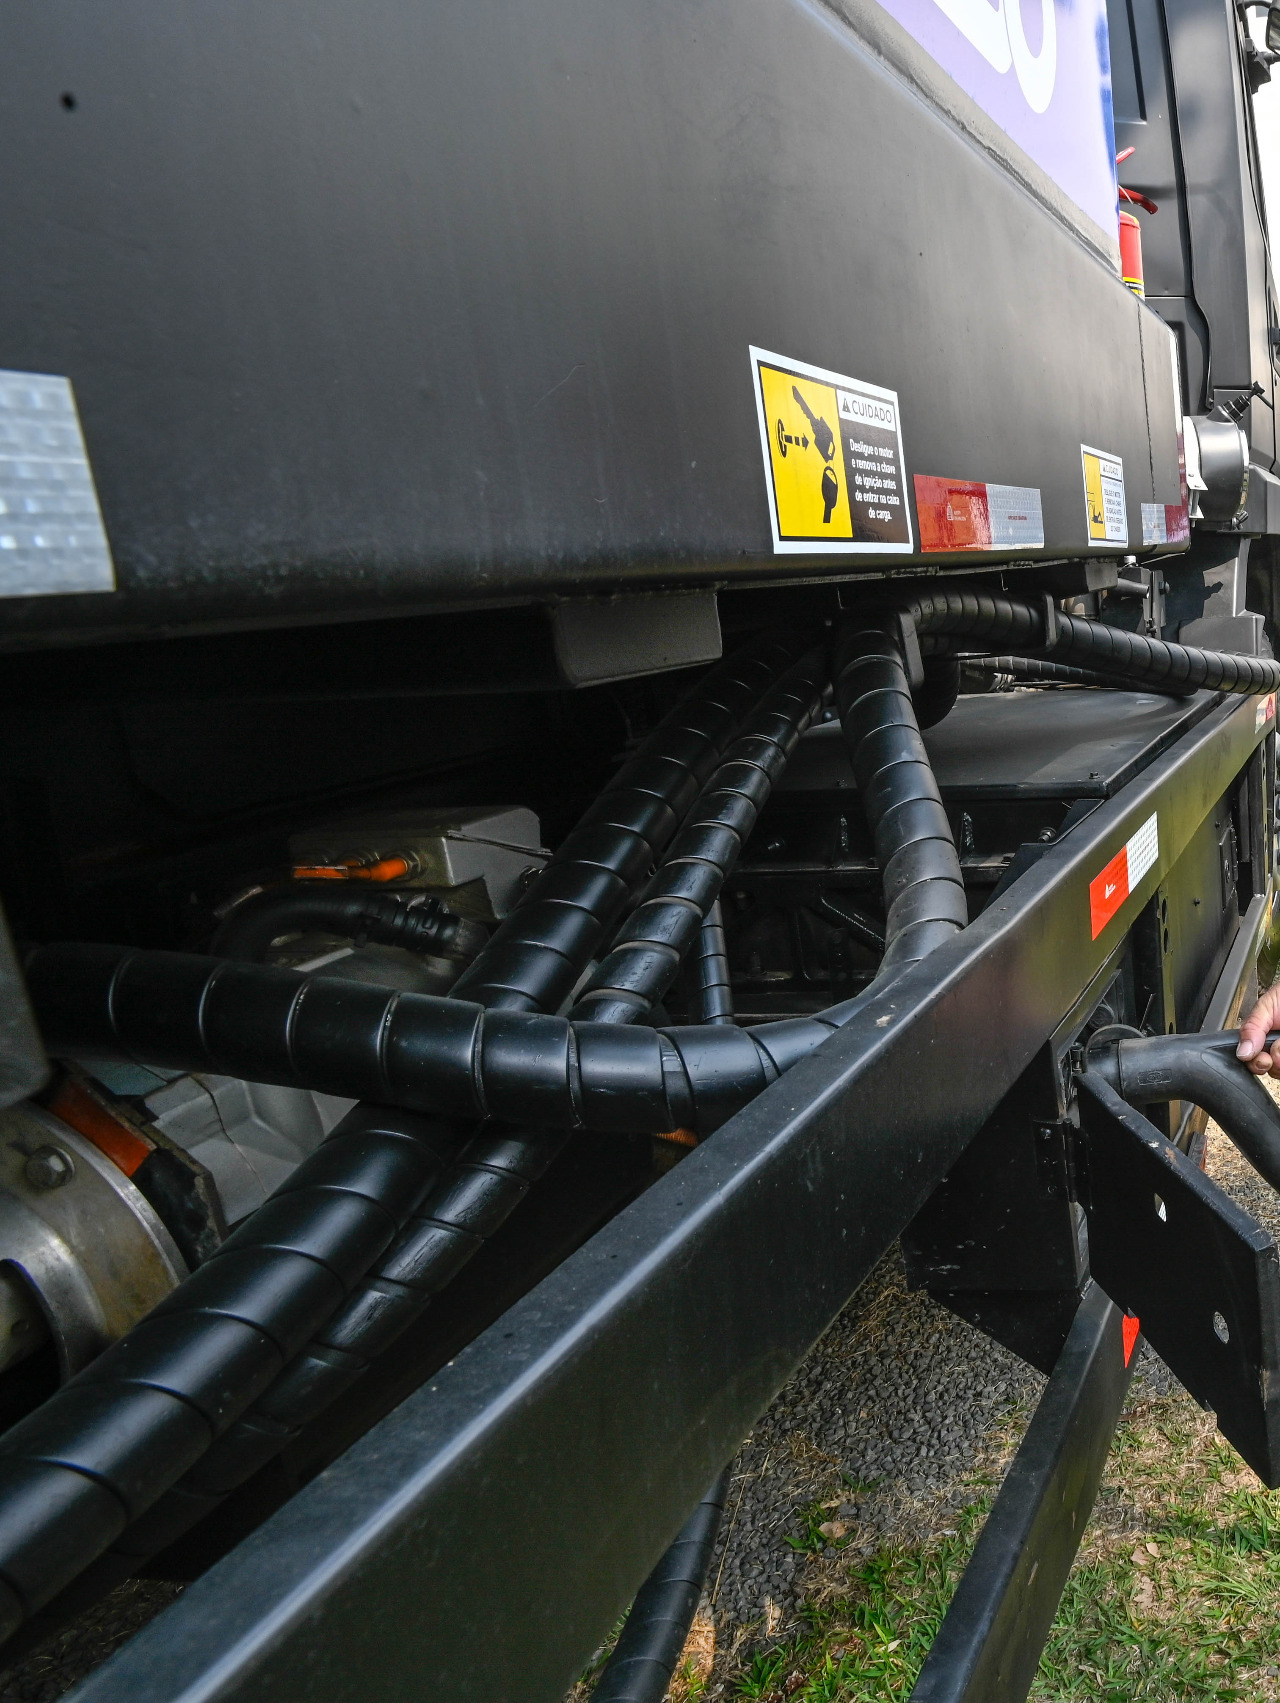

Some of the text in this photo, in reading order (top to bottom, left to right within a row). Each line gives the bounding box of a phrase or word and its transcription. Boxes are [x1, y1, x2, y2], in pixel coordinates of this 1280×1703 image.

[852, 400, 892, 424] CUIDADO
[849, 438, 894, 459] Desligue o motor
[852, 458, 896, 474] e remova a chave
[855, 473, 896, 490] de ignição antes
[855, 490, 900, 505] de entrar na caixa
[868, 507, 892, 522] de carga.
